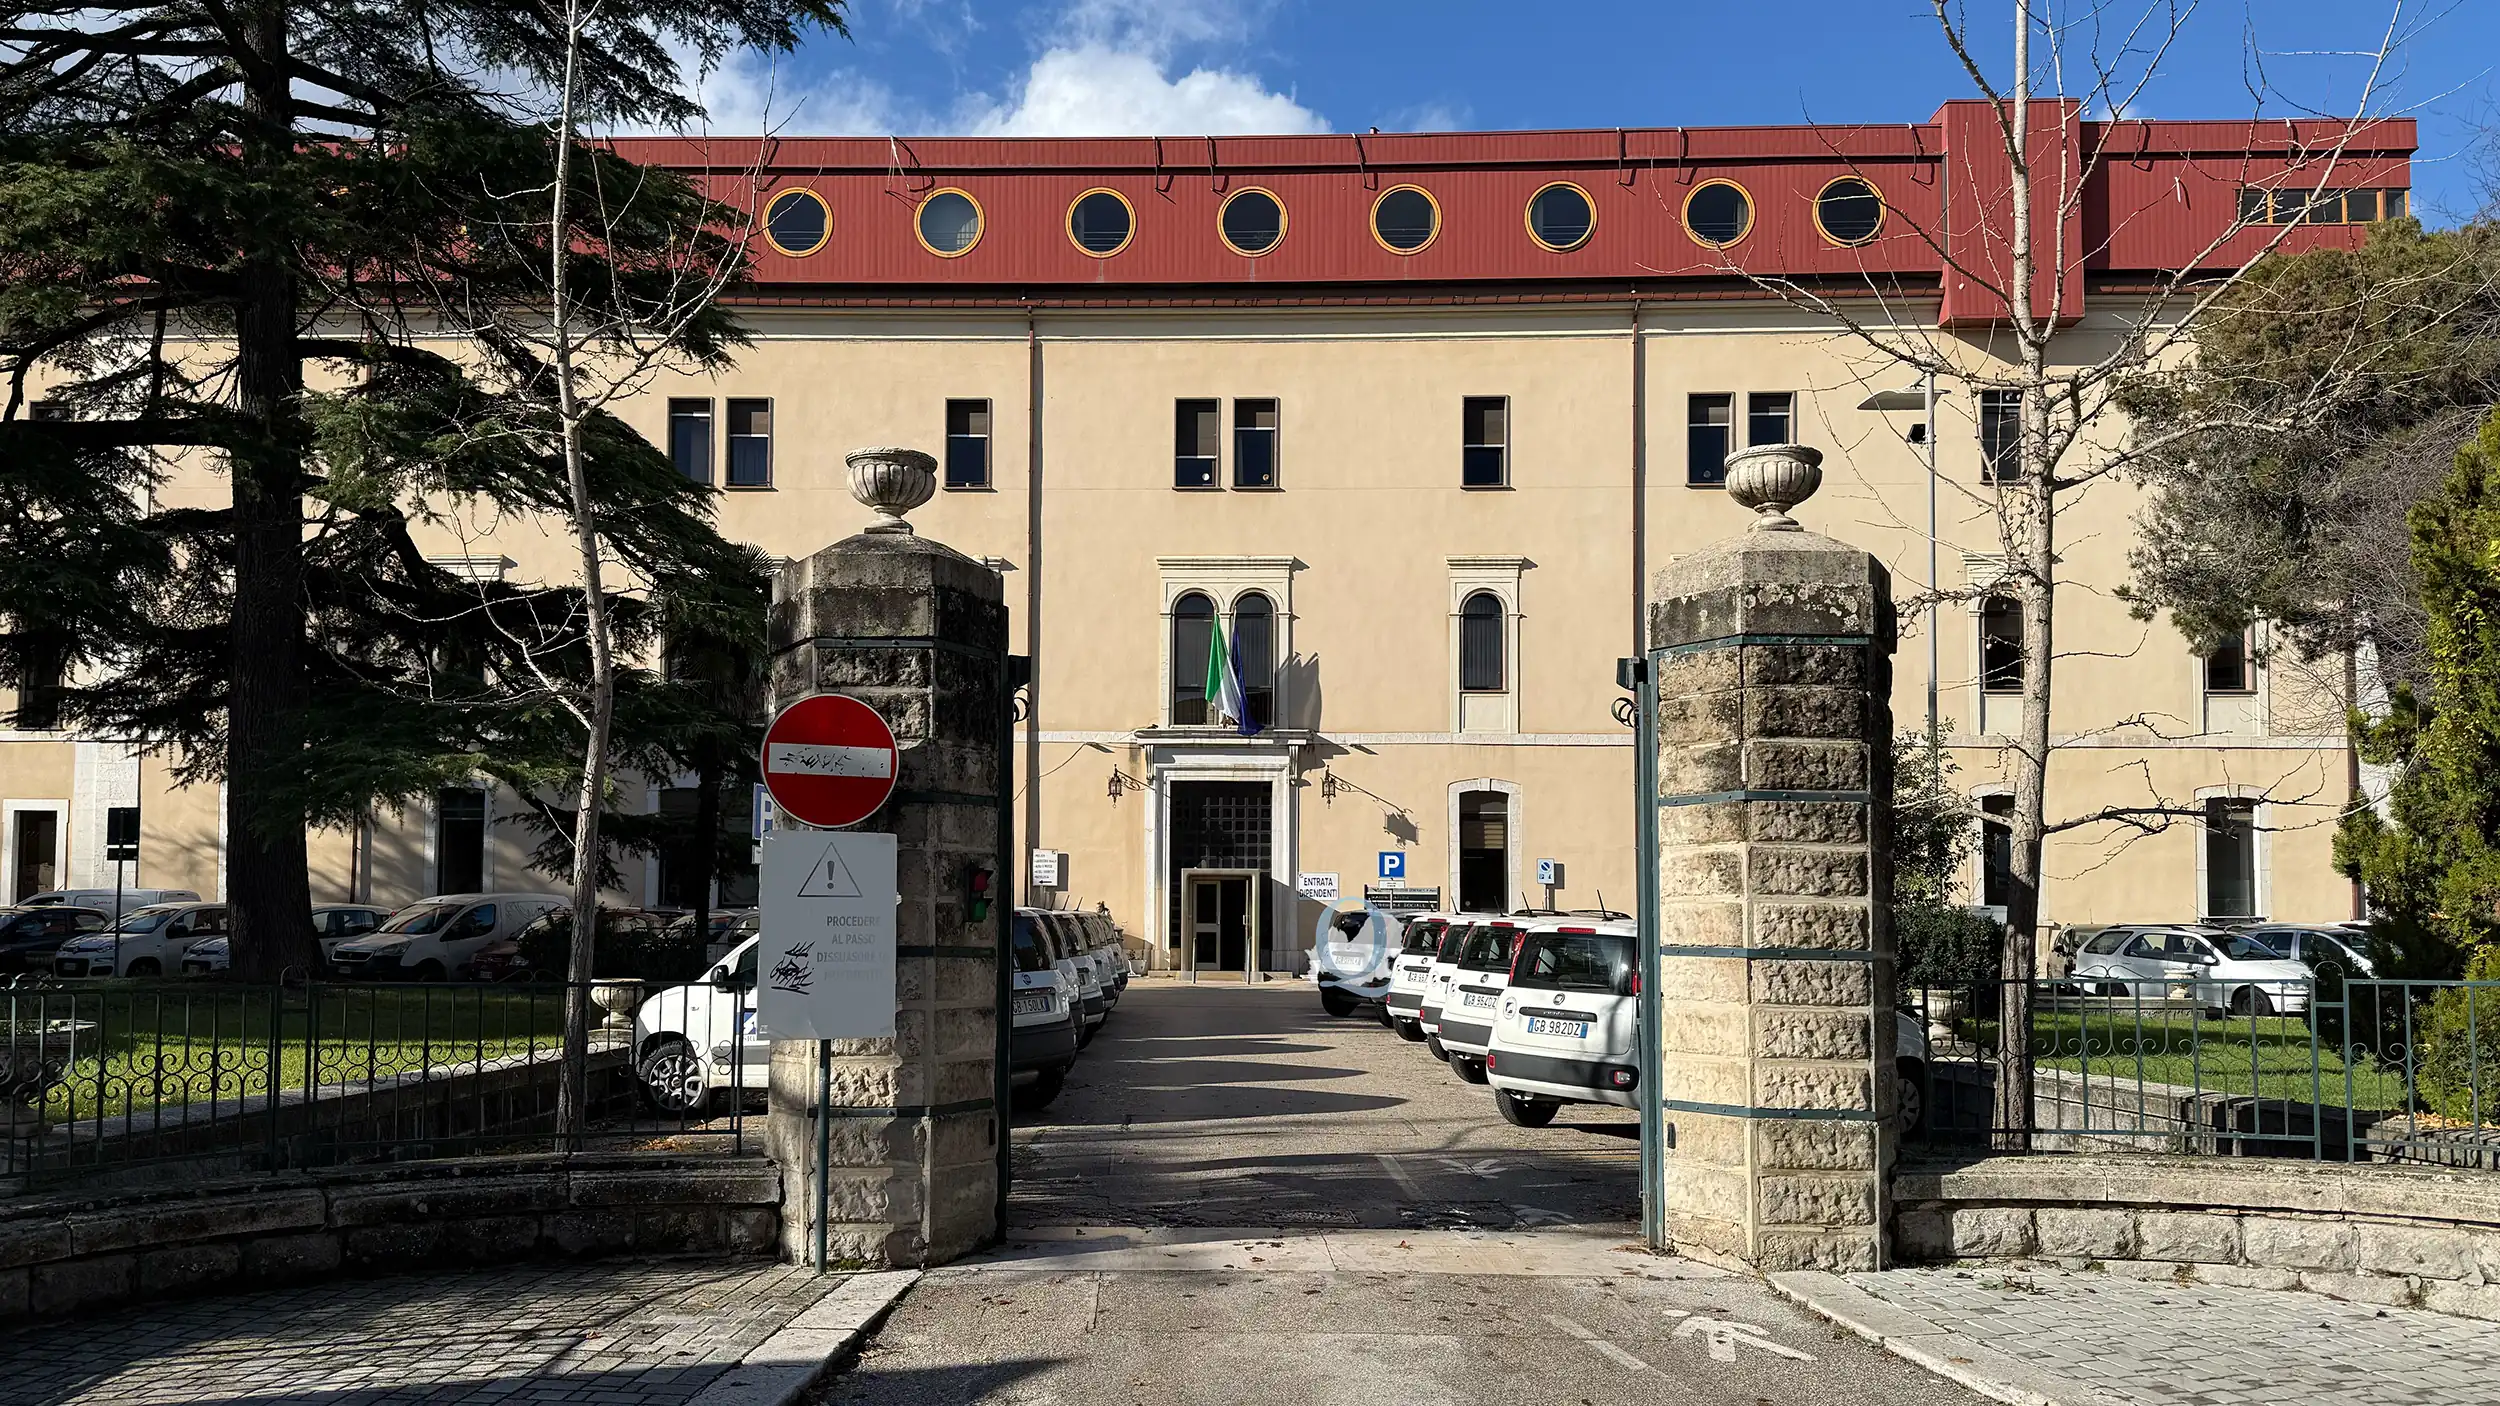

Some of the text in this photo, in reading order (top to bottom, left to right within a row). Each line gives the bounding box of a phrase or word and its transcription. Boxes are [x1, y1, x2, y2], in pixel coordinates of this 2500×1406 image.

[1384, 855, 1400, 875] P
[1303, 877, 1334, 887] ENTRATA
[1299, 888, 1338, 898] DIPENDENTI
[826, 916, 881, 927] PROCEDERE
[832, 933, 876, 945] AL PASSO
[1534, 1019, 1581, 1036] GB 982DZ
